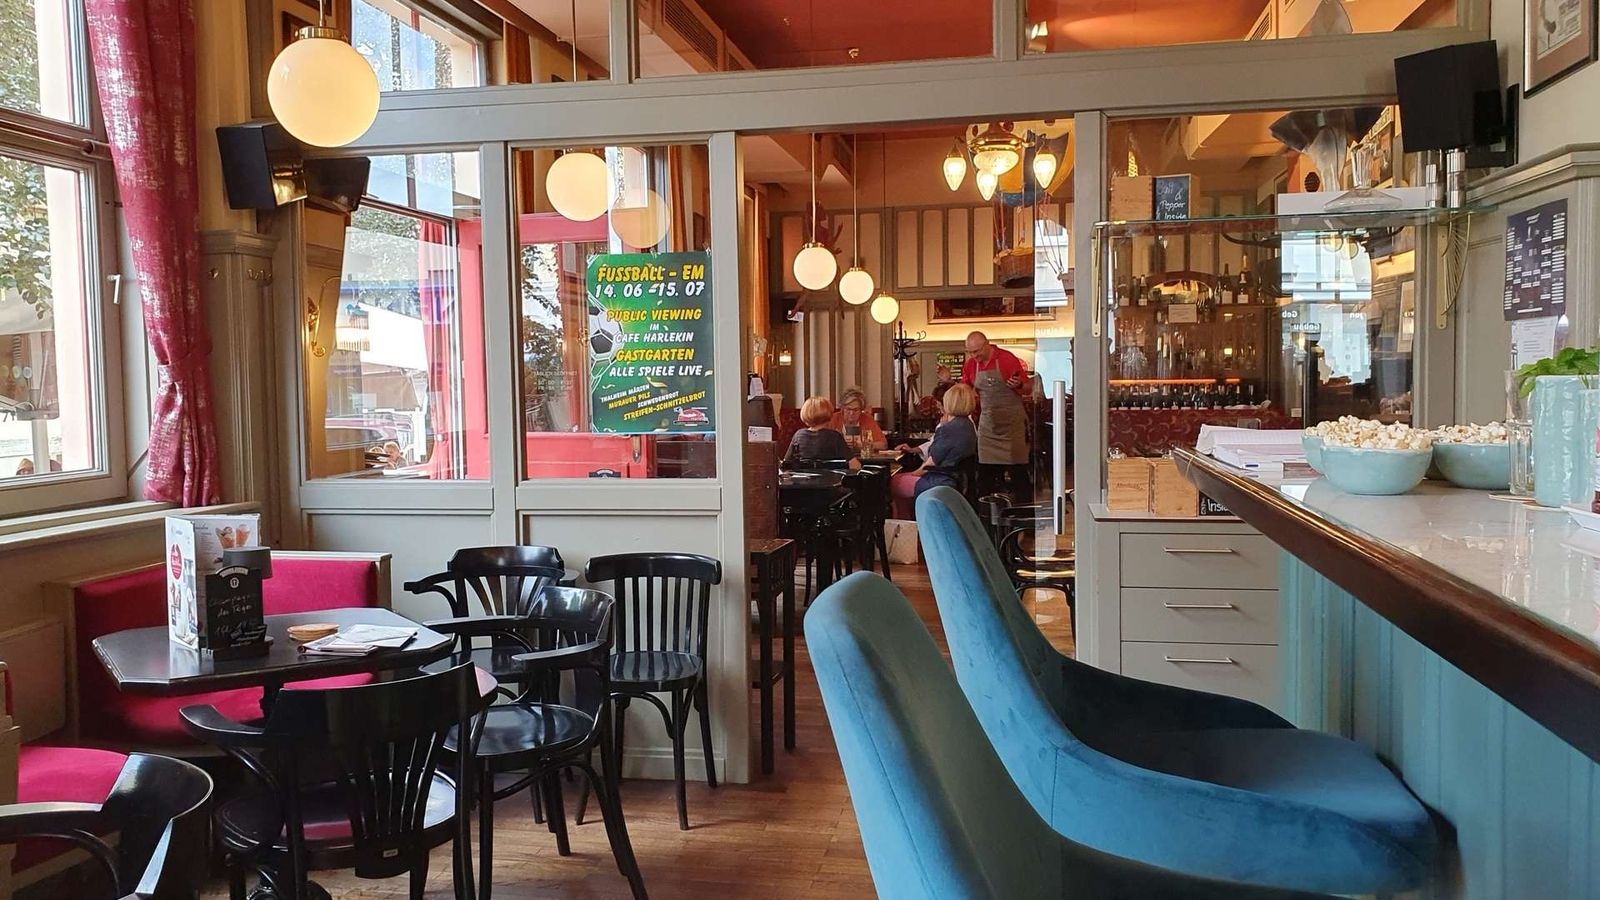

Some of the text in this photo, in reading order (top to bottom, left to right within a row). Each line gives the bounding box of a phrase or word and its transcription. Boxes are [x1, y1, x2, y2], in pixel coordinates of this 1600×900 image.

[1159, 200, 1186, 212] Pepper
[598, 266, 664, 282] FUSSBALL
[682, 264, 705, 280] EM
[594, 283, 617, 298] 14.
[623, 283, 643, 298] 06
[685, 281, 706, 297] 07
[606, 308, 702, 322] PUBLIC VIEWING
[649, 323, 660, 331] IM
[615, 331, 694, 343] CAFE HARLEKIN
[616, 348, 695, 362] GASTGARTEN
[609, 364, 703, 377] ALLE SPIELE LIVE
[638, 391, 652, 402] PILS
[623, 390, 707, 421] STREIFEN-SCHNITZELBROT
